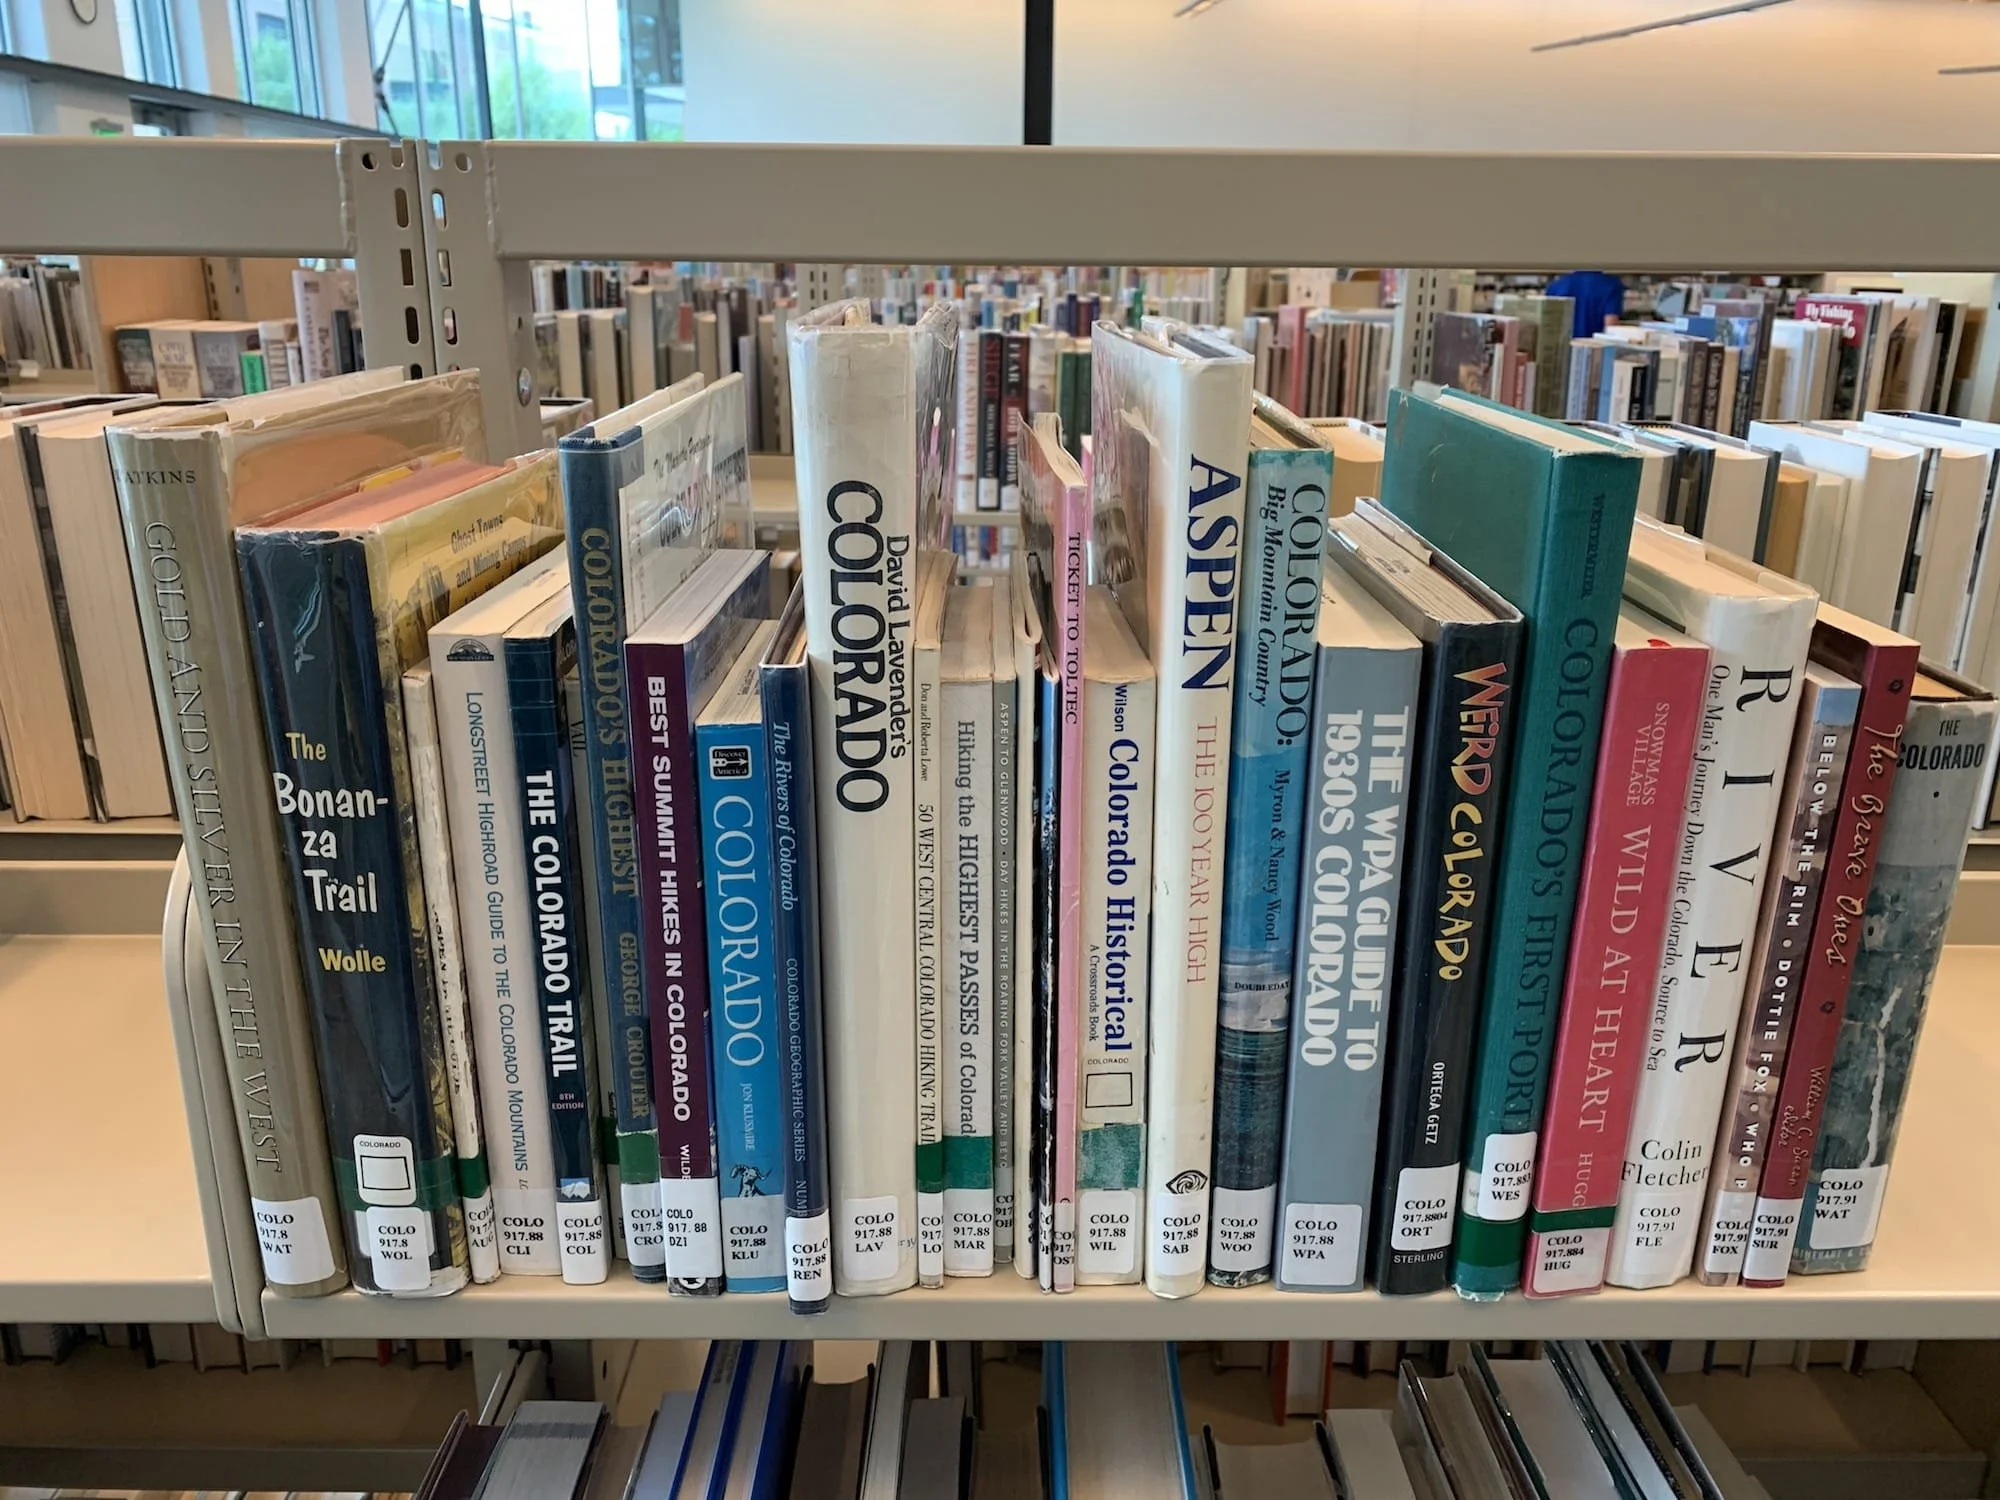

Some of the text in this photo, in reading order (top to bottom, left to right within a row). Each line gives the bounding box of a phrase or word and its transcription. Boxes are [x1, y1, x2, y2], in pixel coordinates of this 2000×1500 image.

[451, 523, 477, 554] Ghost
[1181, 453, 1242, 692] ASPEN
[1249, 483, 1287, 708] Big Mountain Country
[1065, 532, 1081, 725] TICKET TO TOLTEC
[1275, 483, 1326, 747] COLORADO:
[826, 480, 890, 813] COLORADO
[886, 535, 912, 760] David Lavender's
[920, 683, 932, 700] Don
[1114, 684, 1128, 732] Wilson
[581, 527, 640, 898] COLORADO'S HIGHEST
[285, 732, 327, 761] The
[920, 719, 932, 757] Roberta
[1194, 717, 1218, 779] THE
[1641, 702, 1671, 806] SNOWMASS
[1863, 723, 1903, 781] The
[920, 758, 932, 782] Lowe
[1000, 703, 1009, 846] ASPEN TO GLENWOOD
[1626, 725, 1651, 807] VILLAGE
[272, 772, 389, 818] Bonan-
[773, 721, 798, 911] The Rivers of Colorado
[1515, 618, 1599, 1016] COLORADO'S FIRST
[144, 521, 283, 1173] GOLD AND SILVER IN THE WEST
[301, 829, 338, 859] za
[1263, 768, 1291, 942] Myron & Nancy Wood
[1844, 794, 1884, 881] Brave
[1188, 834, 1213, 909] YEAR
[1646, 664, 1731, 1073] One Man's Journey Down the Colorado, Source to Sea
[303, 869, 378, 913] Trail
[647, 676, 691, 1122] BEST SUMMIT HIKES IN COLORADO
[955, 720, 979, 1059] Hiking the HIGHEST PASSES of
[1104, 738, 1140, 1053] Colorado Historical
[1300, 709, 1365, 1068] 1930S COLORADO
[1343, 706, 1410, 1072] THE WPA GUIDE TO
[465, 691, 528, 1172] LONGSTREET HIGHROAD GUIDE TO THE COLORADO MOUNTAINS
[526, 770, 578, 1078] THE COLORADO TRAIL
[712, 795, 765, 1067] COLORADO
[318, 947, 386, 973] Wolle
[918, 804, 937, 1098] 50 WEST CENTRAL COLORADO HIKING
[1186, 916, 1210, 984] HIGH
[1739, 734, 1837, 1168] BELOW THE RIM DOTTIE FOX WHO
[786, 958, 801, 1031] COLORADO
[1088, 944, 1100, 1042] A Crossroads Book
[1578, 824, 1652, 1134] WILD AT HEART
[1000, 861, 1009, 1137] DAY HIKES IN THE ROARING FORK VALLEY AND
[619, 931, 650, 1119] GEORGE CROUTER
[1425, 1061, 1446, 1145] ORTEGA GETZ
[793, 1125, 806, 1163] SERIES
[1641, 1138, 1703, 1161] Colin
[1494, 1160, 1531, 1173] COLO
[1621, 1161, 1709, 1187] Fletcher
[1404, 1198, 1446, 1211] COLO
[1491, 1190, 1521, 1201] WES
[1639, 1206, 1681, 1218] COLO
[378, 1225, 416, 1235] COLO
[502, 1216, 544, 1227] COLO
[503, 1231, 545, 1242] 917.88
[729, 1225, 768, 1235] COLO
[854, 1212, 895, 1226] COLO
[854, 1226, 893, 1240] 917.88
[1089, 1214, 1130, 1225] COLO
[1089, 1227, 1127, 1238] 917.88
[1294, 1220, 1338, 1231] COLO
[1401, 1226, 1433, 1238] ORT
[1637, 1221, 1676, 1233] 917.91
[1755, 1227, 1789, 1237] 917.91
[1757, 1214, 1795, 1225] COLO
[379, 1238, 409, 1248] 917.8
[381, 1250, 413, 1261] WOL
[506, 1245, 531, 1256] CLI
[730, 1238, 767, 1248] 917.88
[731, 1250, 760, 1261] KLU
[855, 1241, 884, 1254] LAV
[1089, 1241, 1117, 1252] WIL
[1292, 1235, 1335, 1246] 917.88
[1292, 1249, 1326, 1260] WPA
[1393, 1251, 1444, 1264] STERLING
[1635, 1236, 1664, 1247] FLE
[1712, 1245, 1739, 1254] FOX
[1752, 1240, 1778, 1249] SUR
